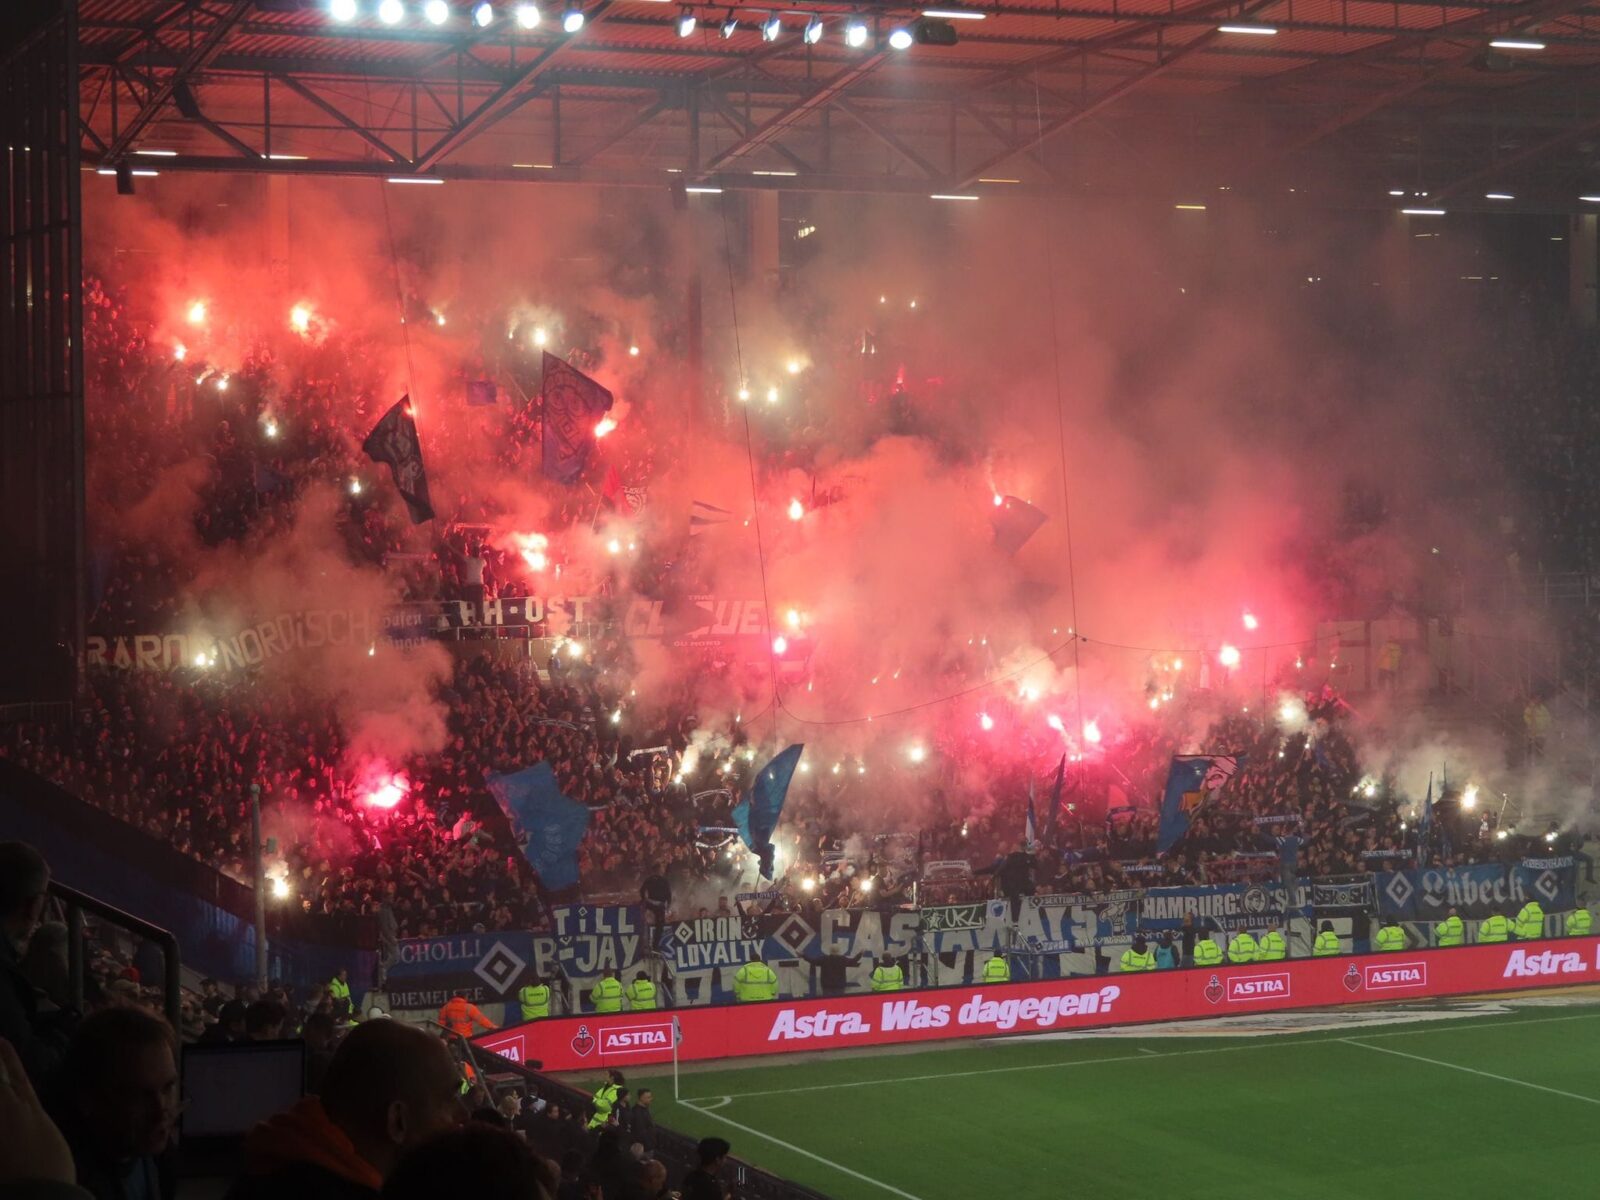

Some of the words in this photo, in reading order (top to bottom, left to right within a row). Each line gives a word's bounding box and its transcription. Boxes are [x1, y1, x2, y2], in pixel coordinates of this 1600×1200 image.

[624, 600, 763, 635] CLUE
[694, 916, 742, 943] IRON
[676, 939, 766, 969] LOYALTY
[1503, 949, 1588, 979] Astra.
[1233, 979, 1285, 995] ASTRA
[1371, 968, 1421, 984] ASTRA
[767, 1009, 871, 1041] Astra.
[881, 1000, 951, 1031] Was
[957, 985, 1120, 1029] dagegen?
[606, 1030, 667, 1048] ASTRA
